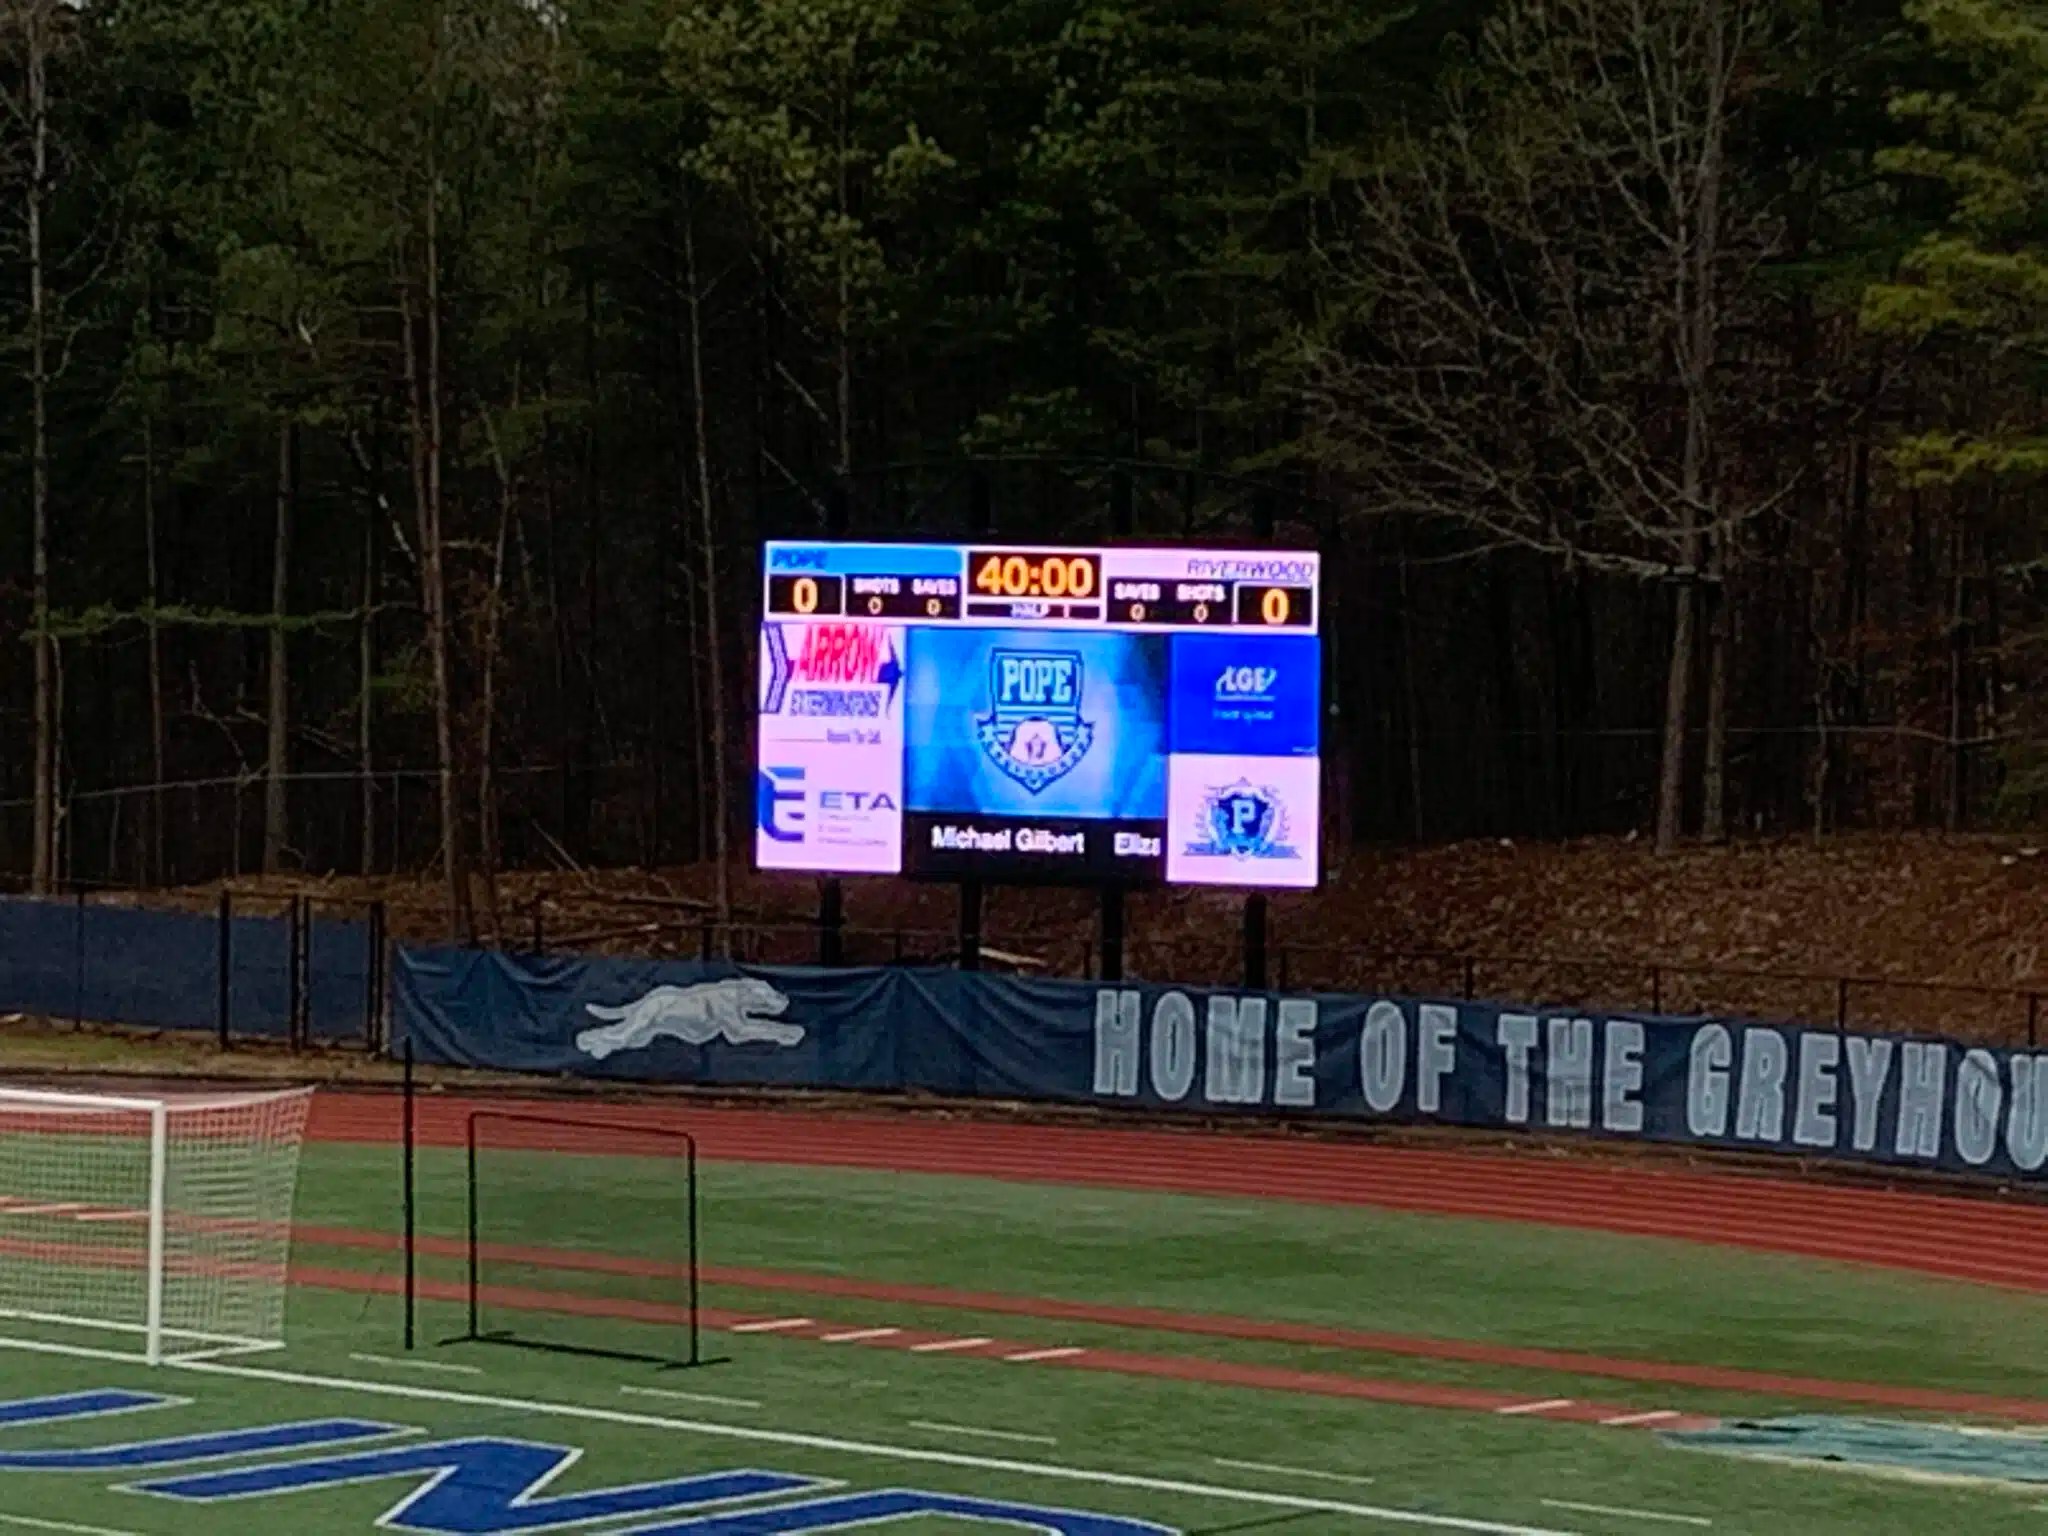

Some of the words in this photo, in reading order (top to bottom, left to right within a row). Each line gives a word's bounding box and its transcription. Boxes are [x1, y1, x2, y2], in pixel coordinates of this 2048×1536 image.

[976, 556, 1094, 597] 40:00
[1187, 558, 1314, 579] RIVERWOOD
[793, 577, 818, 613] 0
[854, 577, 900, 595] SHOTS
[1114, 583, 1161, 601] SAVES
[1177, 584, 1226, 602] SHOTS
[867, 596, 884, 615] 0
[926, 598, 942, 616] 0
[1130, 603, 1146, 621] 0
[1193, 603, 1209, 622] 0
[1261, 588, 1289, 625] 0
[796, 624, 884, 683] ARROW
[1001, 659, 1072, 703] POPE
[819, 791, 896, 811] ETA
[1232, 799, 1256, 834] P
[931, 825, 1011, 852] Michael
[1016, 828, 1085, 855] Gilbert
[1093, 988, 1319, 1107] HOME
[1360, 999, 1459, 1113] OF
[1497, 1012, 1645, 1132] THE
[1686, 1022, 2048, 1171] GREYHOU
